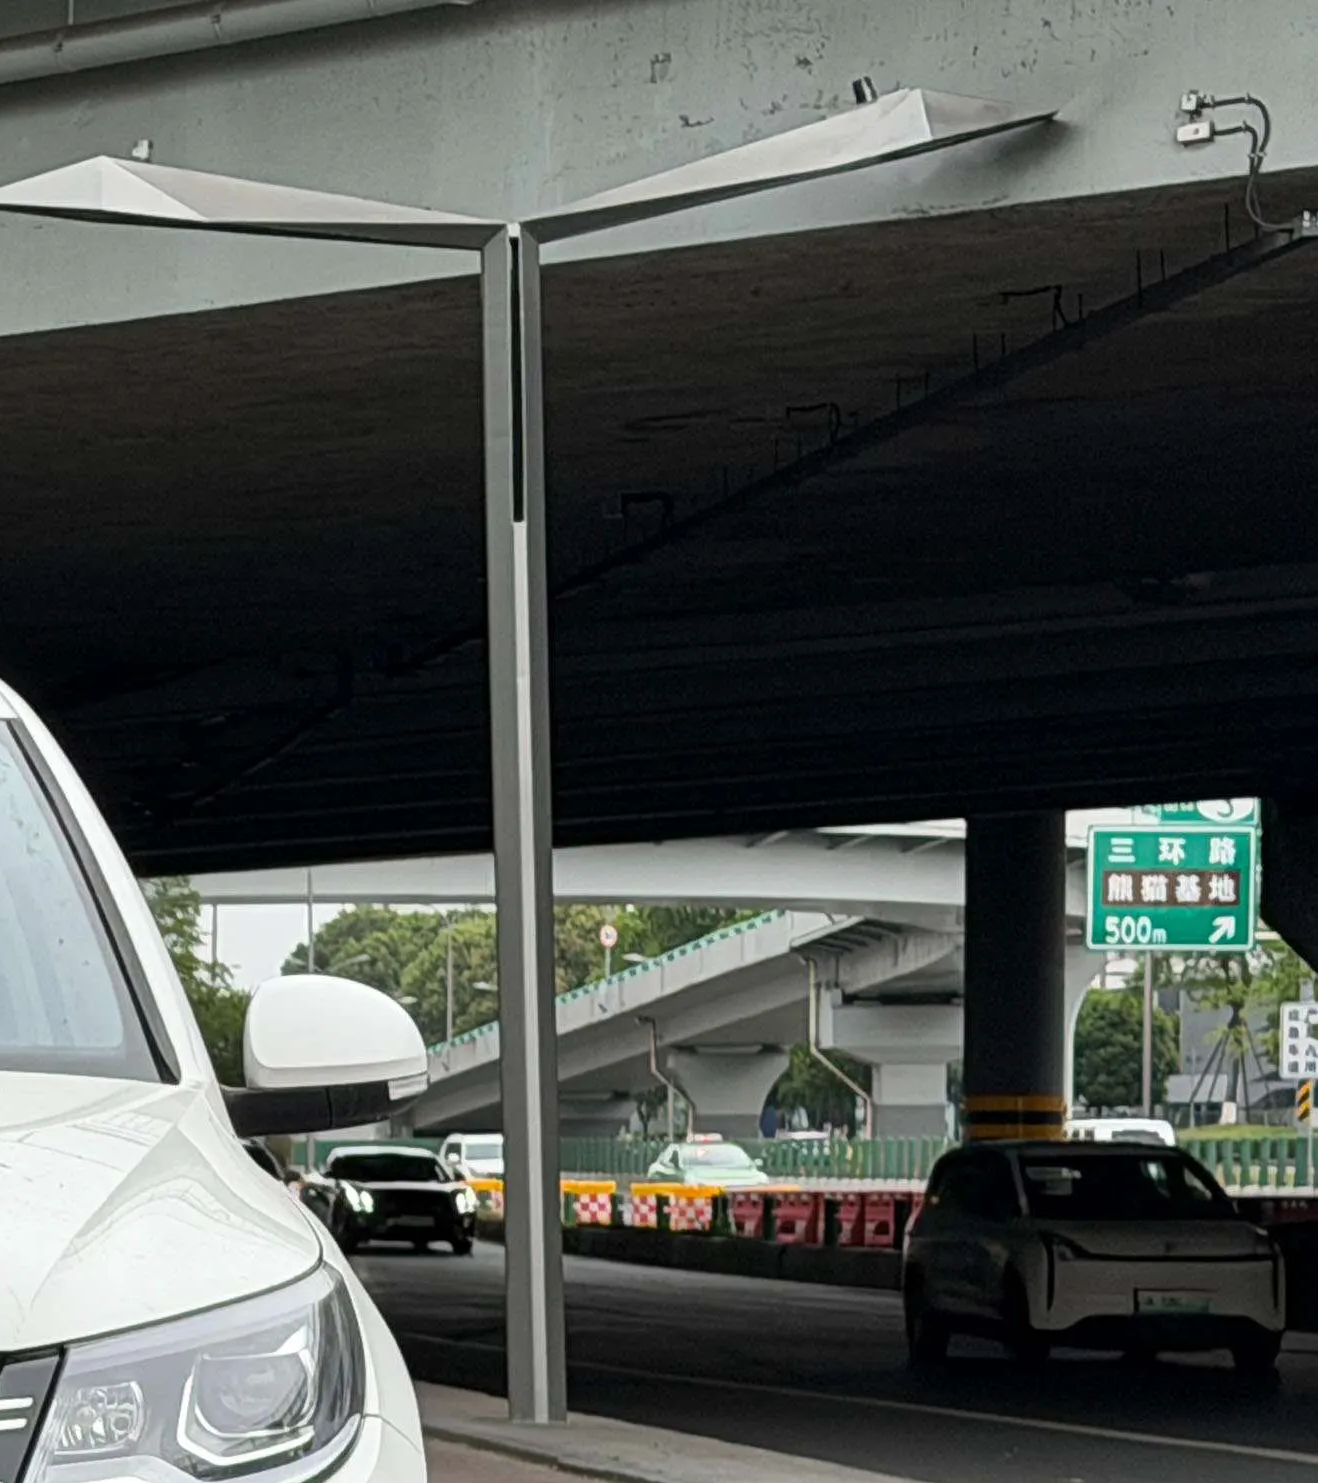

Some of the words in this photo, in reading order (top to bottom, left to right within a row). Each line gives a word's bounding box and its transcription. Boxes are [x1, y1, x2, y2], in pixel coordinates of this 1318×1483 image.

[1108, 837, 1236, 865] 三环路
[1105, 915, 1167, 944] 500m
